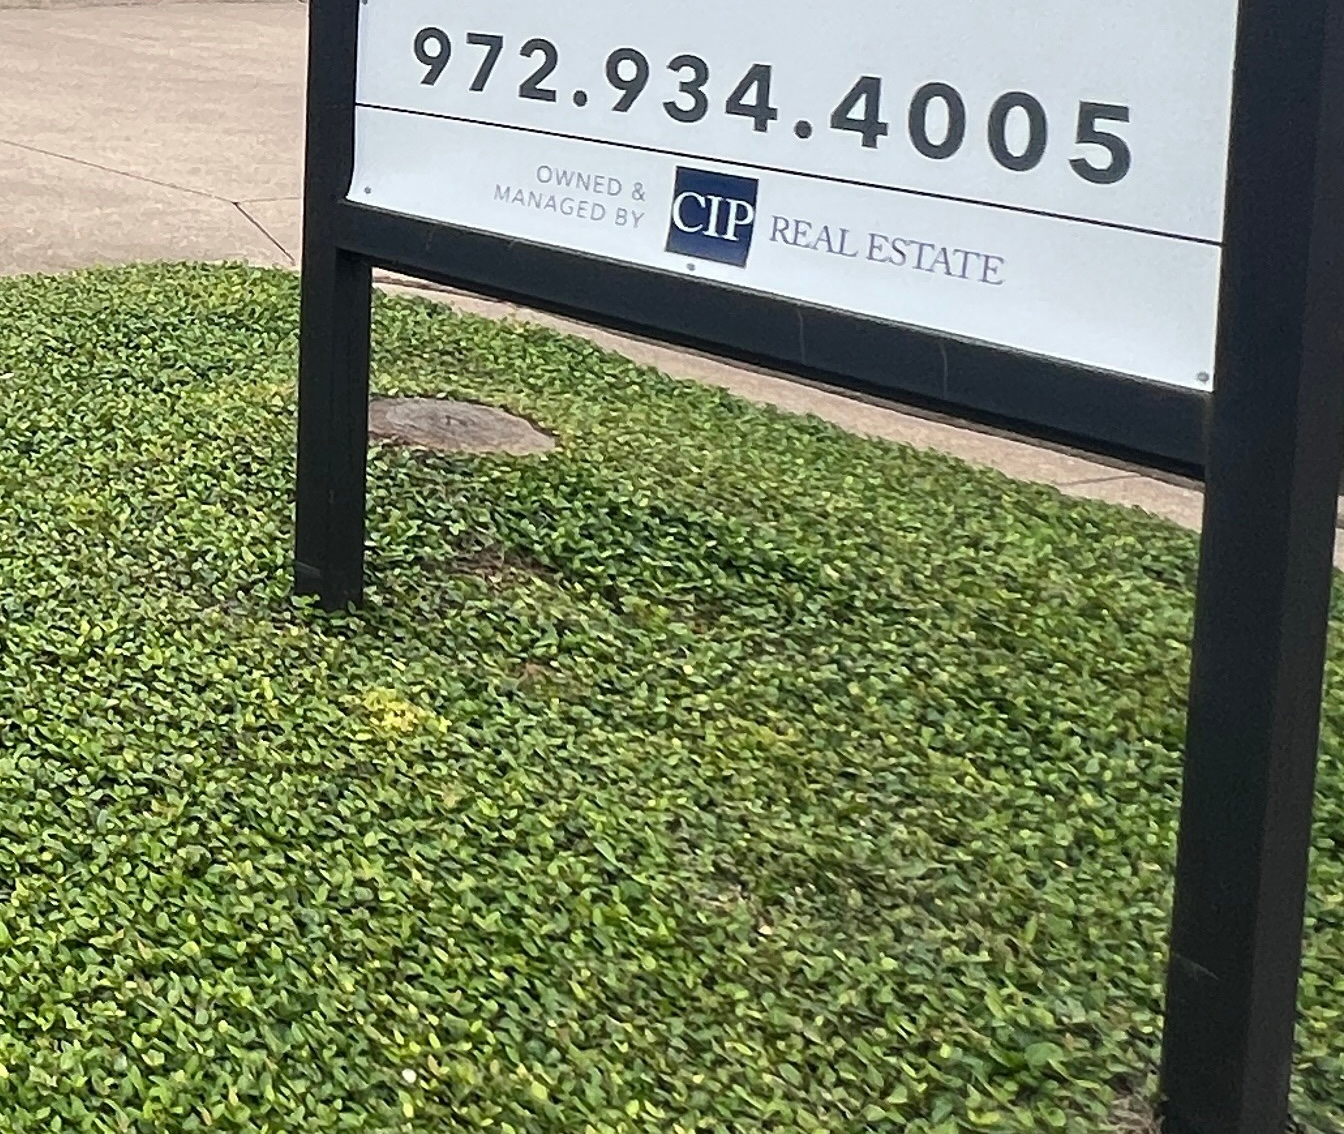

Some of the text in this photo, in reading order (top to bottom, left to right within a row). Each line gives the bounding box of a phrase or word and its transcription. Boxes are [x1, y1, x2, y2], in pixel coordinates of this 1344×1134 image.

[413, 26, 1133, 185] 972.934.4005
[492, 183, 646, 230] MANAGED BY
[535, 165, 647, 203] OWNED &
[670, 190, 1008, 287] CIP REAL ESTATE
